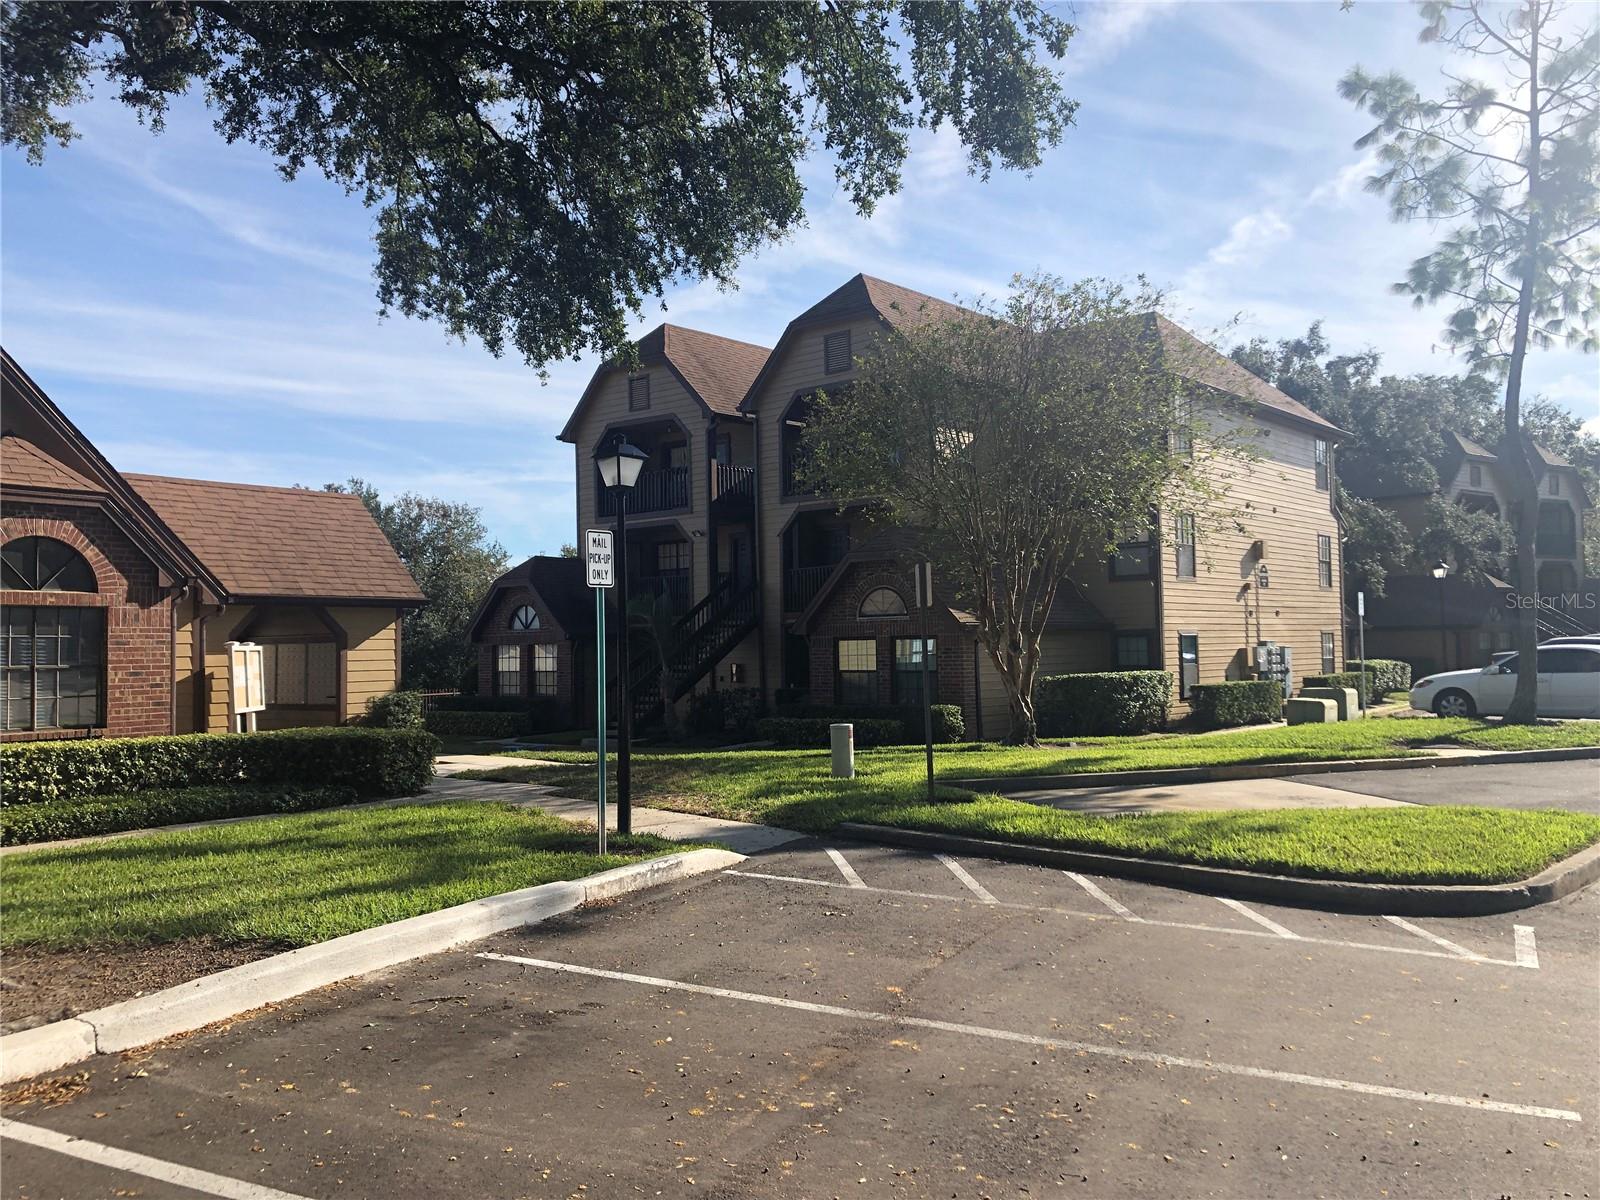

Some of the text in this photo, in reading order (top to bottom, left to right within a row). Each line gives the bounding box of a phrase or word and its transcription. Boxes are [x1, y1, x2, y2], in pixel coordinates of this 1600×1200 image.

[592, 537, 607, 548] MAIL
[589, 553, 611, 564] PICK-UP
[592, 569, 608, 580] ONLY
